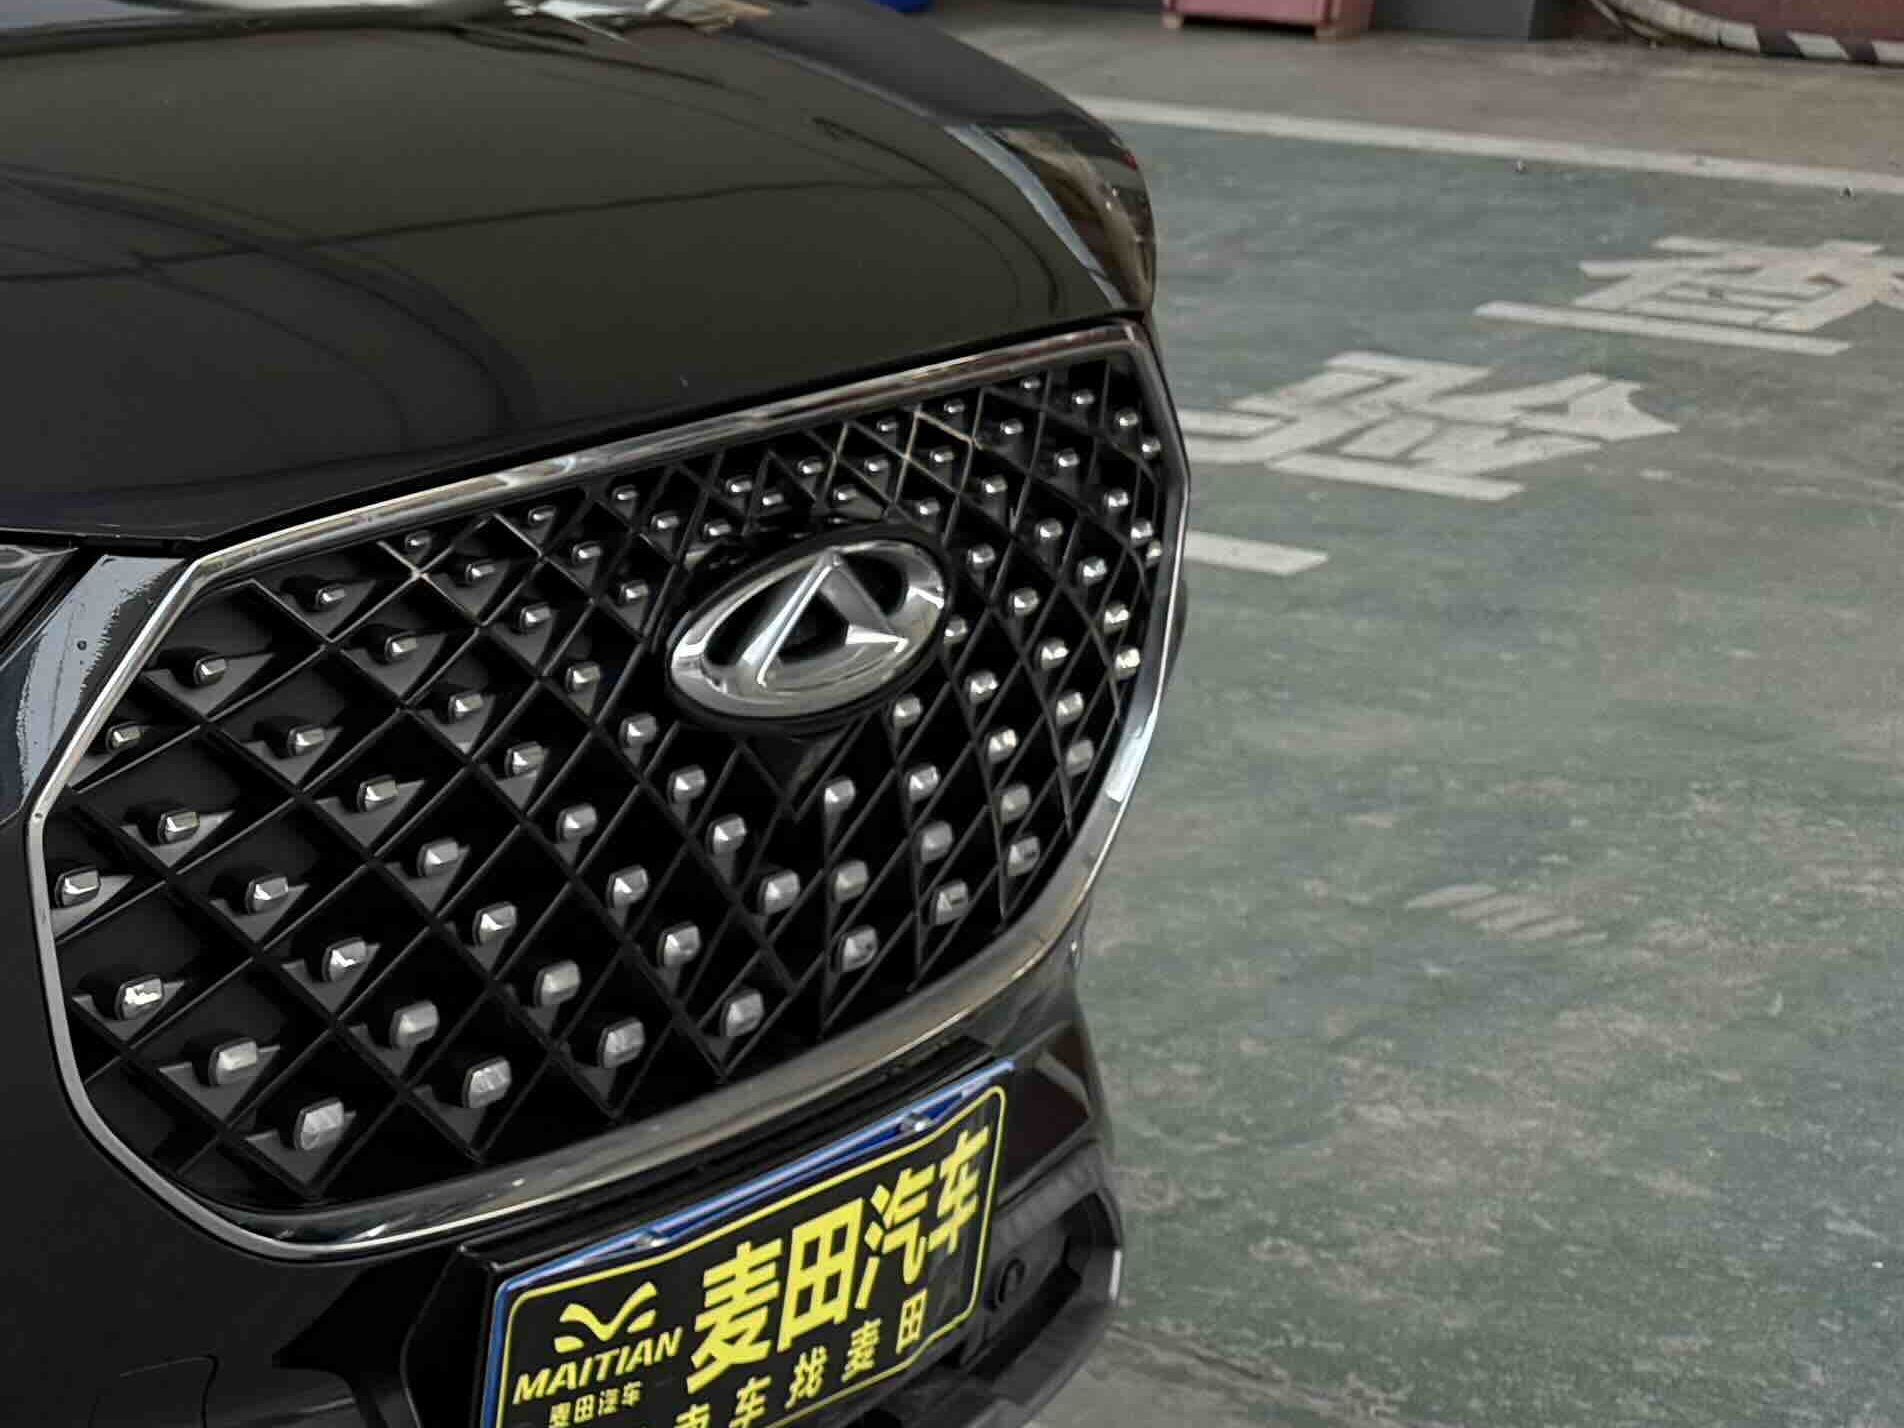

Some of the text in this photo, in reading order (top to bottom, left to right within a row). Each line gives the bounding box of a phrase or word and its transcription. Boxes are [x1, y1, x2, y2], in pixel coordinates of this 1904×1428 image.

[686, 1125, 990, 1395] 麦田汽车
[512, 1326, 684, 1405] MAITIAN
